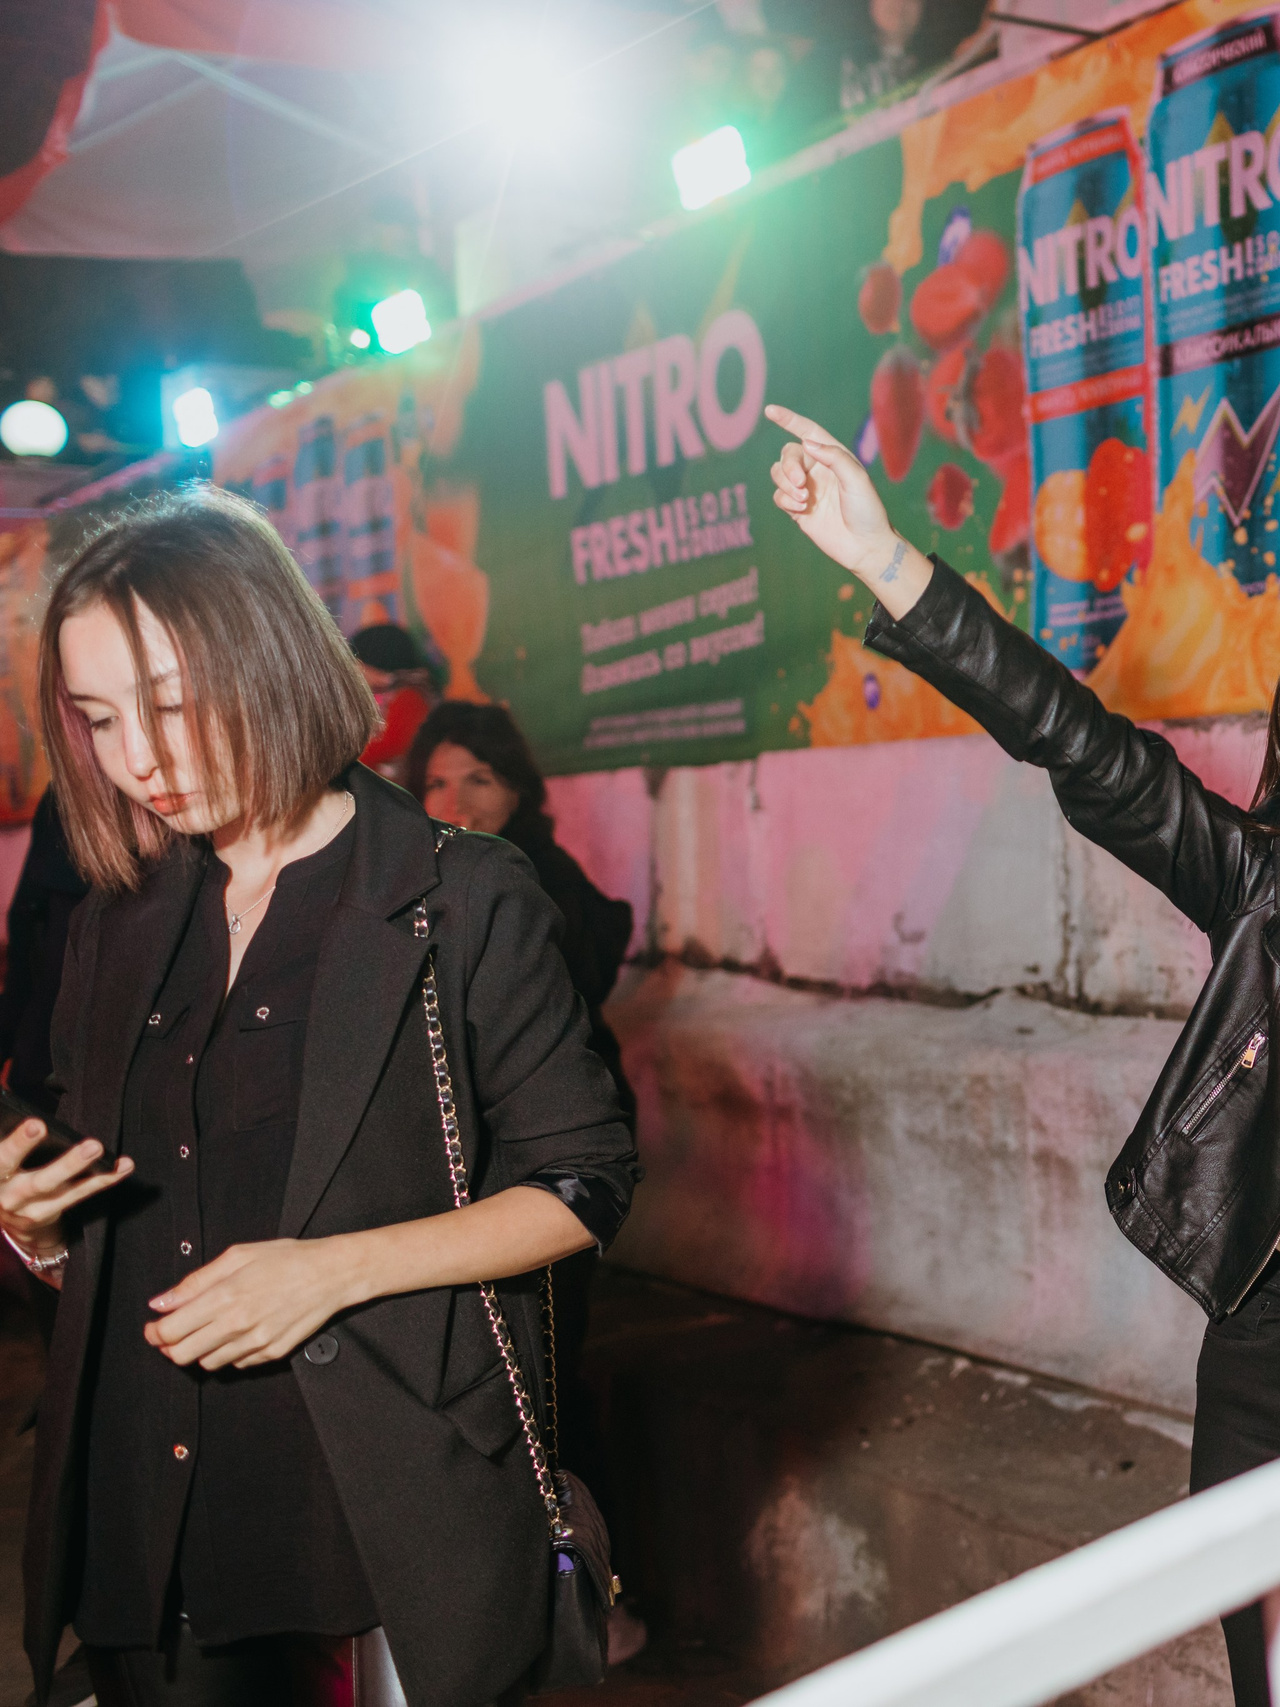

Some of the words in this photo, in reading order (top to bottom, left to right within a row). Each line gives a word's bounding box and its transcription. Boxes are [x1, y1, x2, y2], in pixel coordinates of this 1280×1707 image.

[1018, 205, 1143, 312] NITRO
[1160, 236, 1254, 302] FRESH!
[543, 309, 768, 500] NITRO
[571, 497, 690, 586] FRESH!
